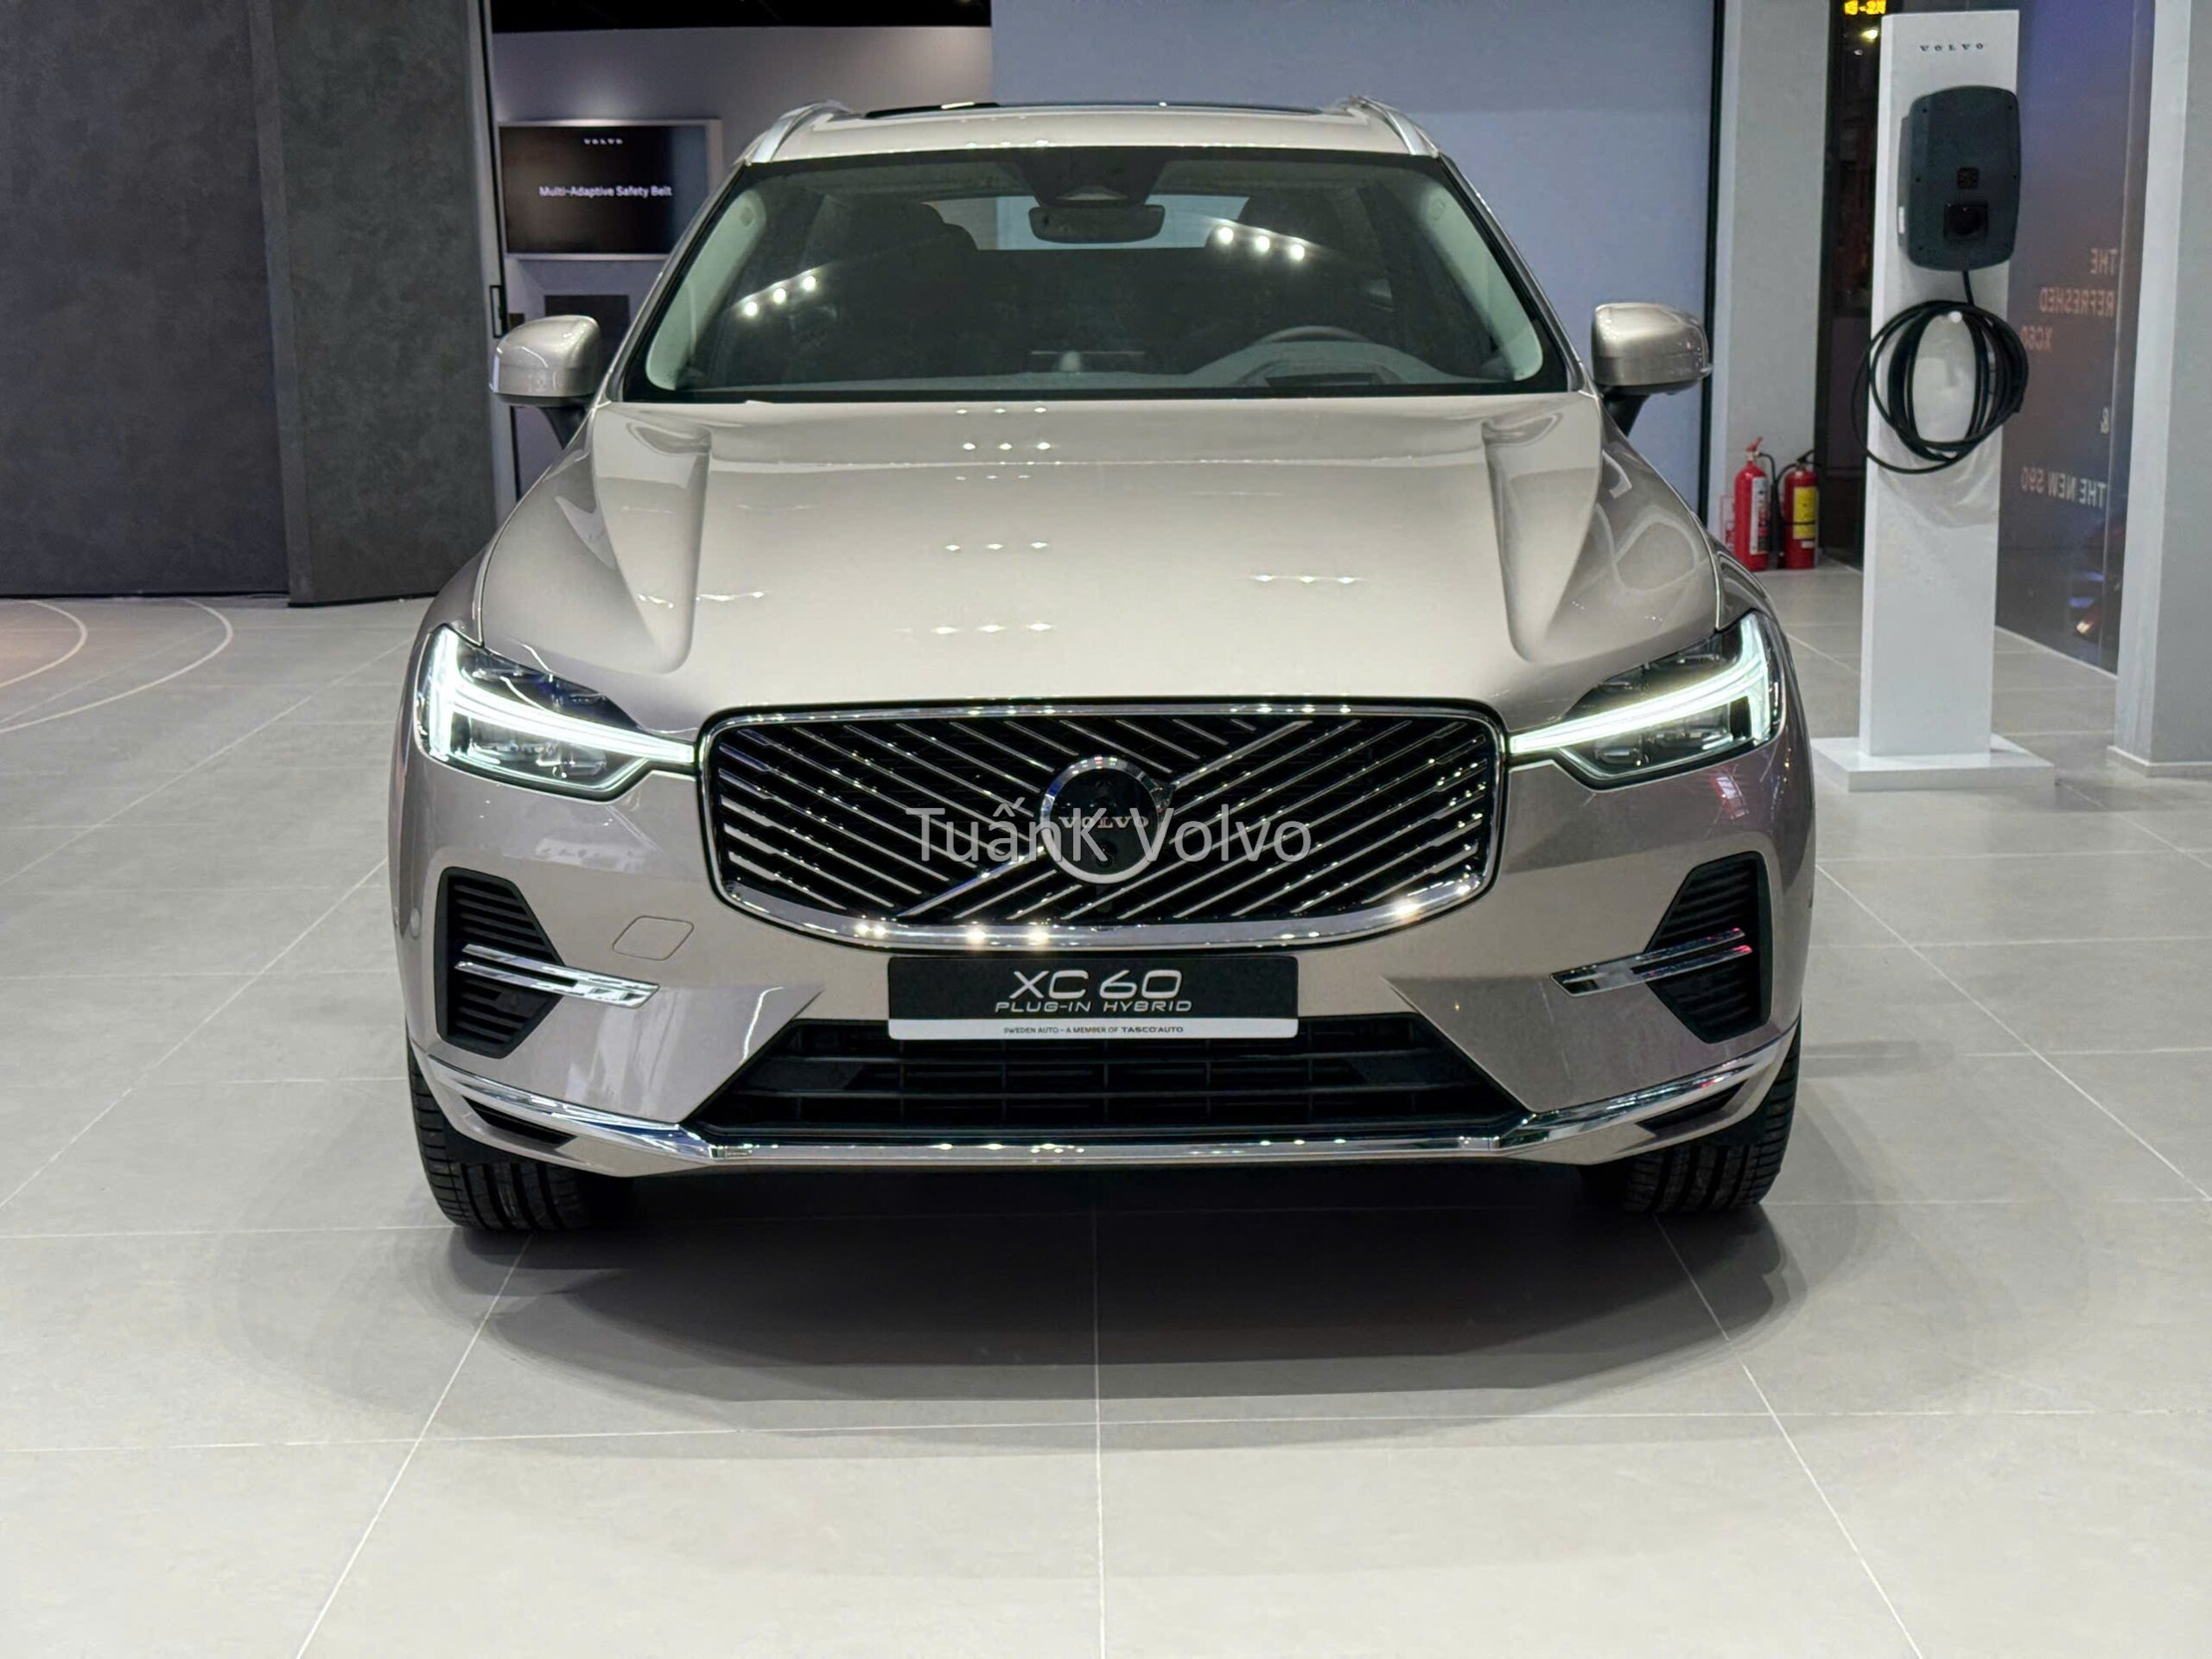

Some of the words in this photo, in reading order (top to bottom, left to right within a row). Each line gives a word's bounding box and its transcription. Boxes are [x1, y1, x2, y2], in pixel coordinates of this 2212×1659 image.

[1920, 42, 1984, 53] VOLVO
[539, 185, 614, 198] Multi-Adaptive
[615, 185, 649, 198] Safety
[650, 185, 673, 197] Belt
[1058, 816, 1150, 830] VOLVO
[995, 1001, 1092, 1014] PLUG-IN
[1103, 1000, 1192, 1013] HYBRID
